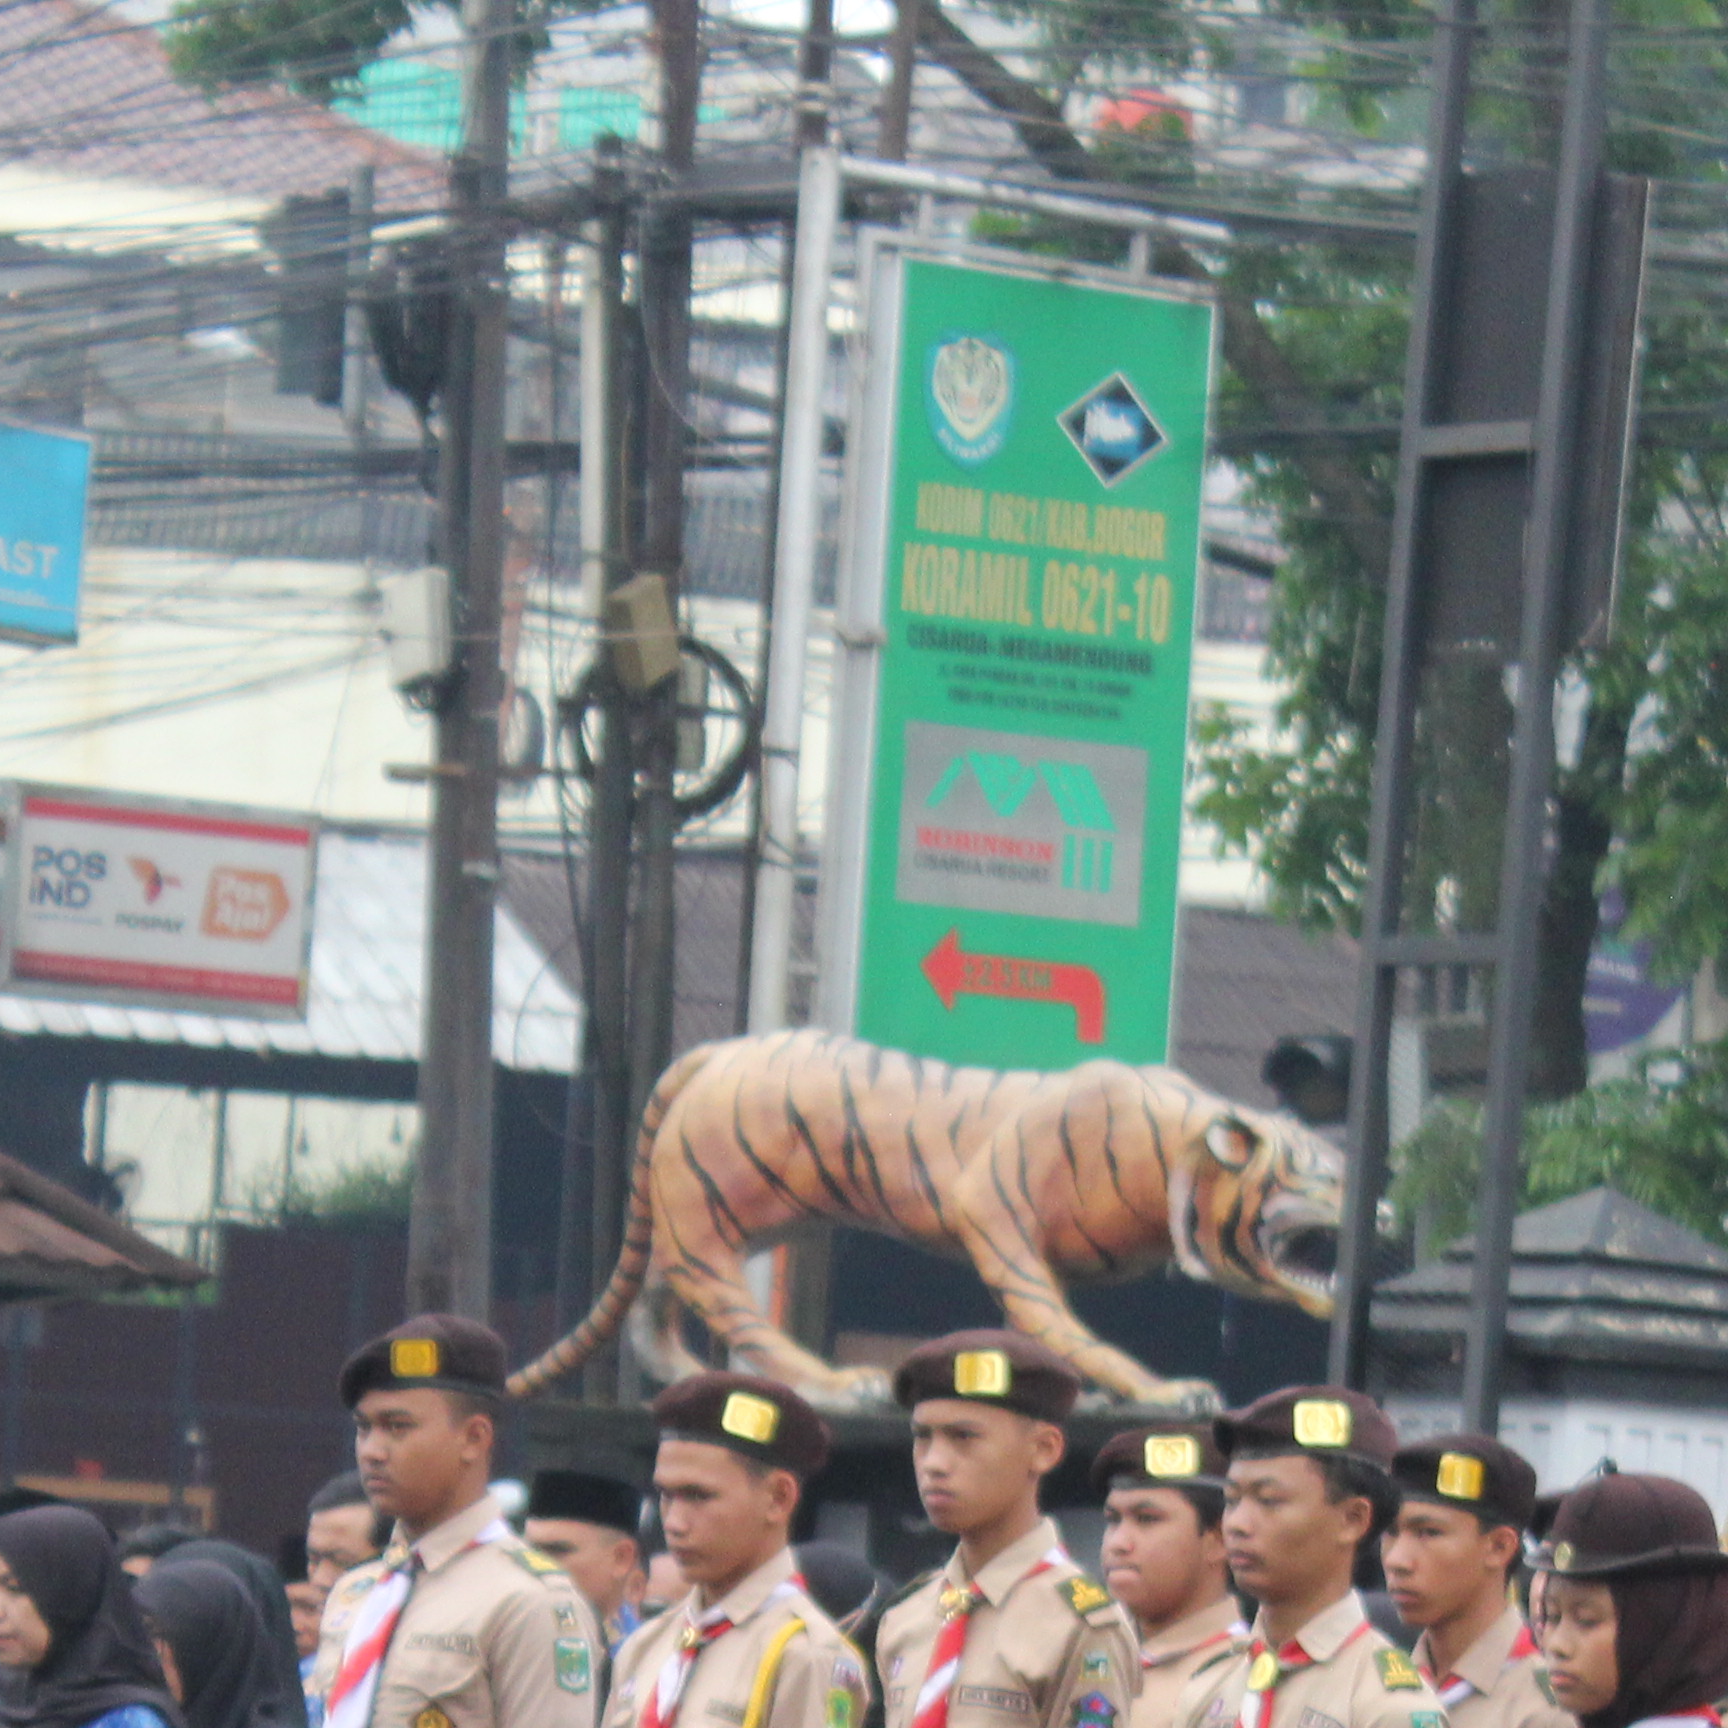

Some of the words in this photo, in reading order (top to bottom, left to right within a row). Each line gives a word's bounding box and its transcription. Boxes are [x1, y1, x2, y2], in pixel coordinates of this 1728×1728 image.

[901, 541, 1033, 627] KORAMIL
[1041, 559, 1172, 645] 0621-10
[917, 826, 1054, 859] ROBINSON
[32, 845, 108, 880] POS
